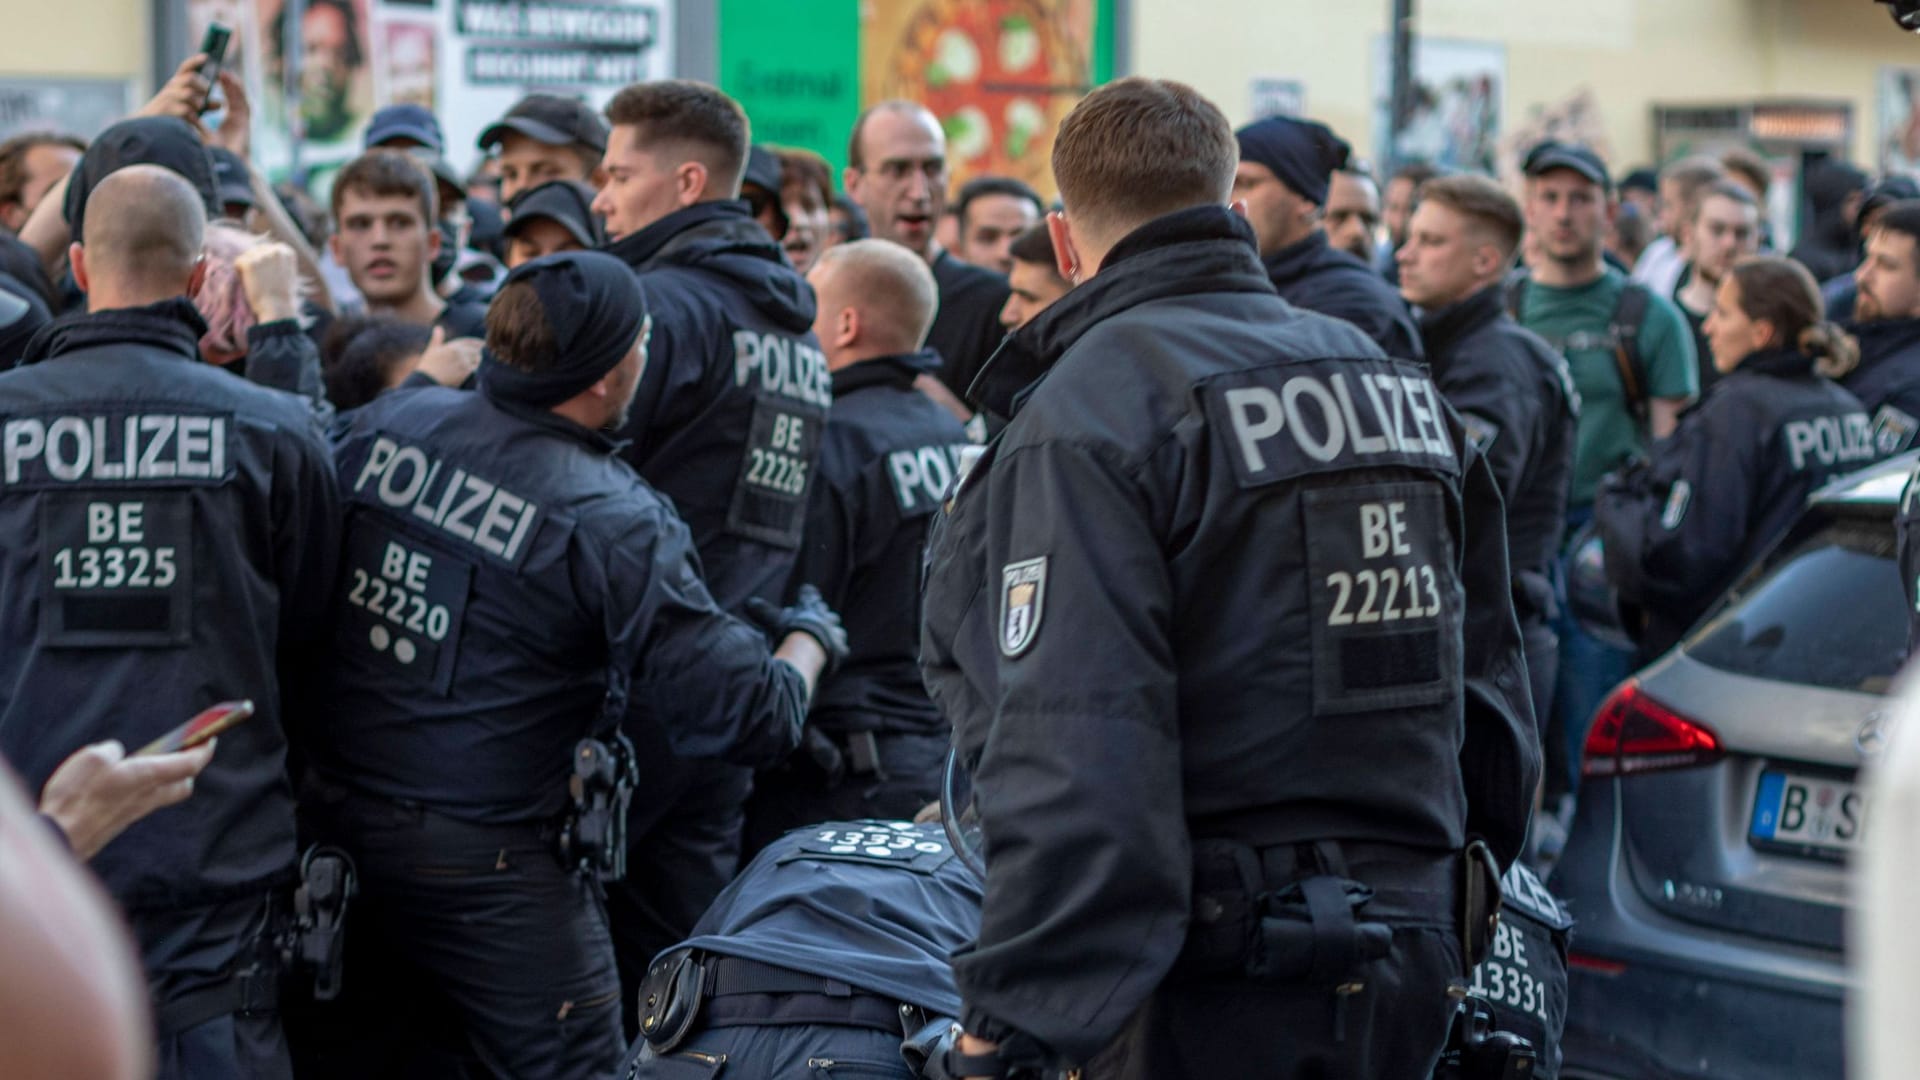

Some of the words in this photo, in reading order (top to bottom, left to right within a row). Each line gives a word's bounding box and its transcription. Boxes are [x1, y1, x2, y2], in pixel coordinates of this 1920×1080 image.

[733, 330, 832, 408] POLIZE
[4, 416, 226, 484] POLIZEI
[771, 413, 803, 453] BE
[1225, 374, 1454, 473] POLIZEI
[88, 503, 144, 543] BE
[354, 437, 537, 562] POLIZEI
[1360, 501, 1411, 559] BE
[54, 547, 176, 588] 13325
[381, 543, 432, 591] BE
[1327, 564, 1442, 626] 22213
[349, 568, 450, 641] 22220
[1780, 785, 1808, 832] B
[1835, 791, 1862, 840] S
[817, 830, 943, 854] 13330
[1494, 921, 1528, 968] BE
[1469, 962, 1547, 1020] 13331
